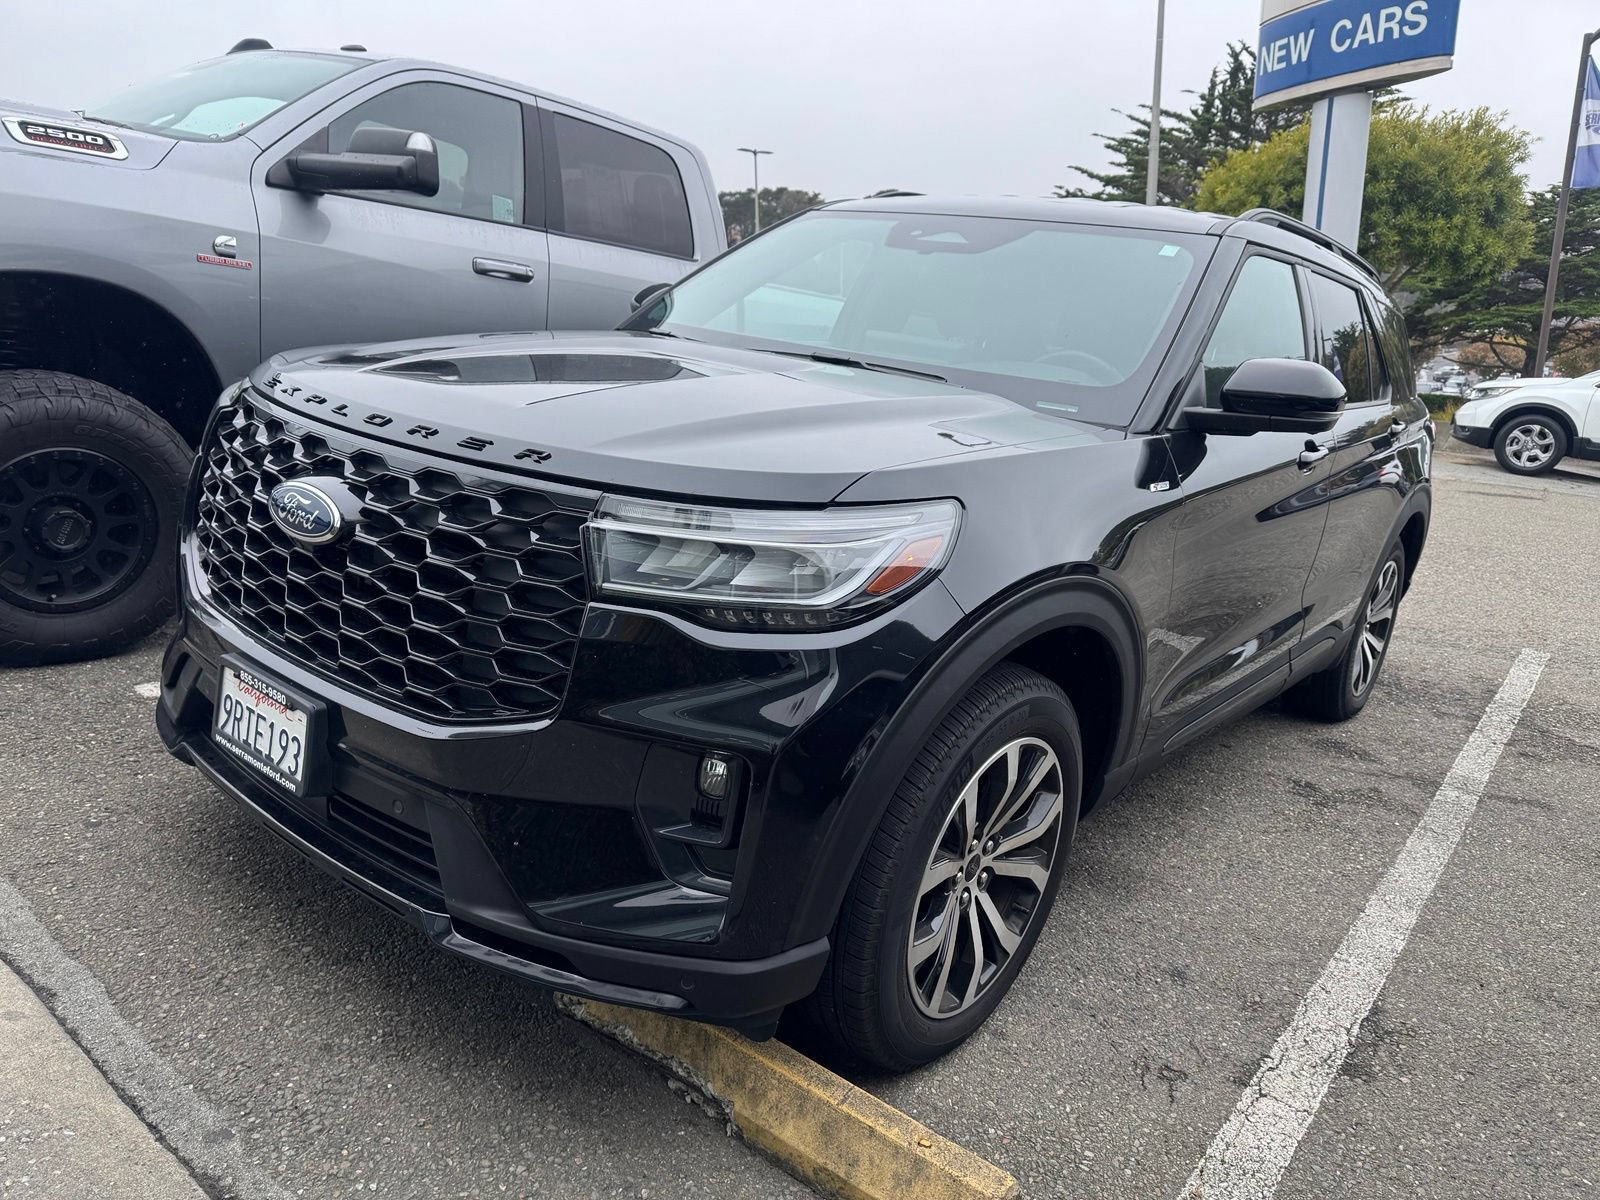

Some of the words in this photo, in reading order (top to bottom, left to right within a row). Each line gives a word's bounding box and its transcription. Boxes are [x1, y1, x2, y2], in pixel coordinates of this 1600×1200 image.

[1259, 28, 1316, 76] NEW
[1330, 0, 1429, 53] CARS
[26, 125, 103, 145] 2500
[263, 372, 552, 464] EXPLORER
[279, 492, 321, 531] Ford
[239, 670, 287, 705] 855-315-9580
[215, 733, 297, 793] www.serramonteford.com
[220, 693, 301, 776] 9RIE193
